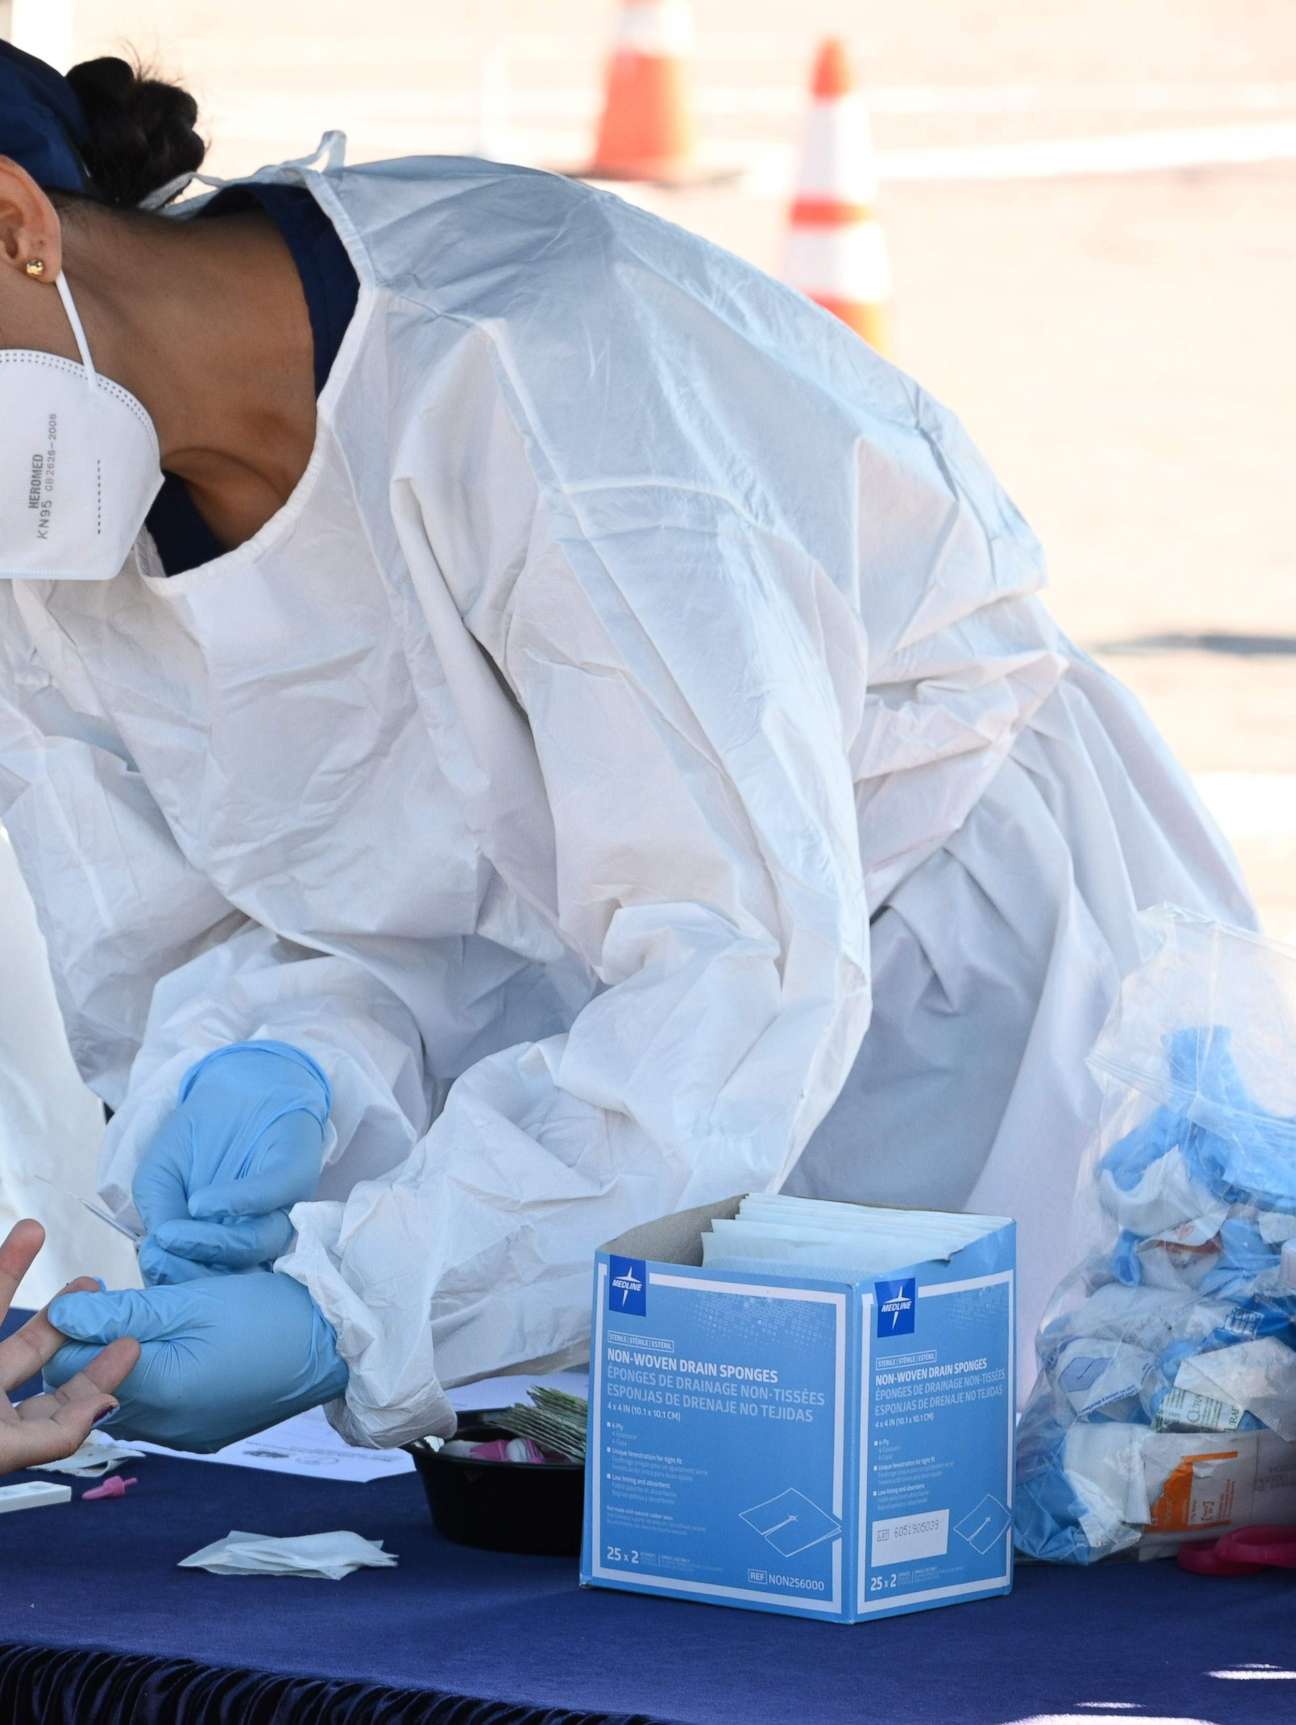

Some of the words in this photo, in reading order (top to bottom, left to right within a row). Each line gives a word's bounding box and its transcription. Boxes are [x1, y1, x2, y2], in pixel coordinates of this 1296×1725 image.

[28, 454, 44, 509] HEROMED
[37, 500, 52, 540] KN95
[612, 1279, 643, 1292] MEDLINE
[881, 1301, 912, 1312] MEDLINE
[607, 1348, 677, 1371] NON-WOVEN
[679, 1359, 717, 1376] DRAIN
[719, 1364, 778, 1383] SPONGES
[875, 1368, 927, 1386] NON-WOVEN
[929, 1364, 952, 1377] DRAIN
[954, 1358, 987, 1374] SPONGES
[607, 1362, 656, 1386] ÉPONGES
[658, 1374, 674, 1388] DE
[676, 1377, 738, 1396] DRAINAGE
[740, 1385, 824, 1406] NON-TISSÉES
[875, 1384, 912, 1401] ÉPONGES
[913, 1385, 923, 1396] DE
[925, 1379, 962, 1393] DRAINAGE
[607, 1383, 663, 1404] ESPONJAS
[665, 1392, 681, 1406] DE
[683, 1395, 737, 1414] DRENAJE
[740, 1403, 757, 1416] NO
[760, 1405, 813, 1422] TEJIDAS
[623, 1403, 631, 1413] IN
[875, 1401, 917, 1416] ESPONJAS
[918, 1398, 928, 1409] DE
[930, 1393, 963, 1408] DRENAJE
[965, 1390, 976, 1401] NO
[977, 1385, 1003, 1399] TEJIDAS
[607, 1546, 621, 1561] 25
[631, 1550, 639, 1564] 2
[751, 1571, 764, 1581] REF
[870, 1576, 882, 1591] 25
[890, 1574, 897, 1588] 2
